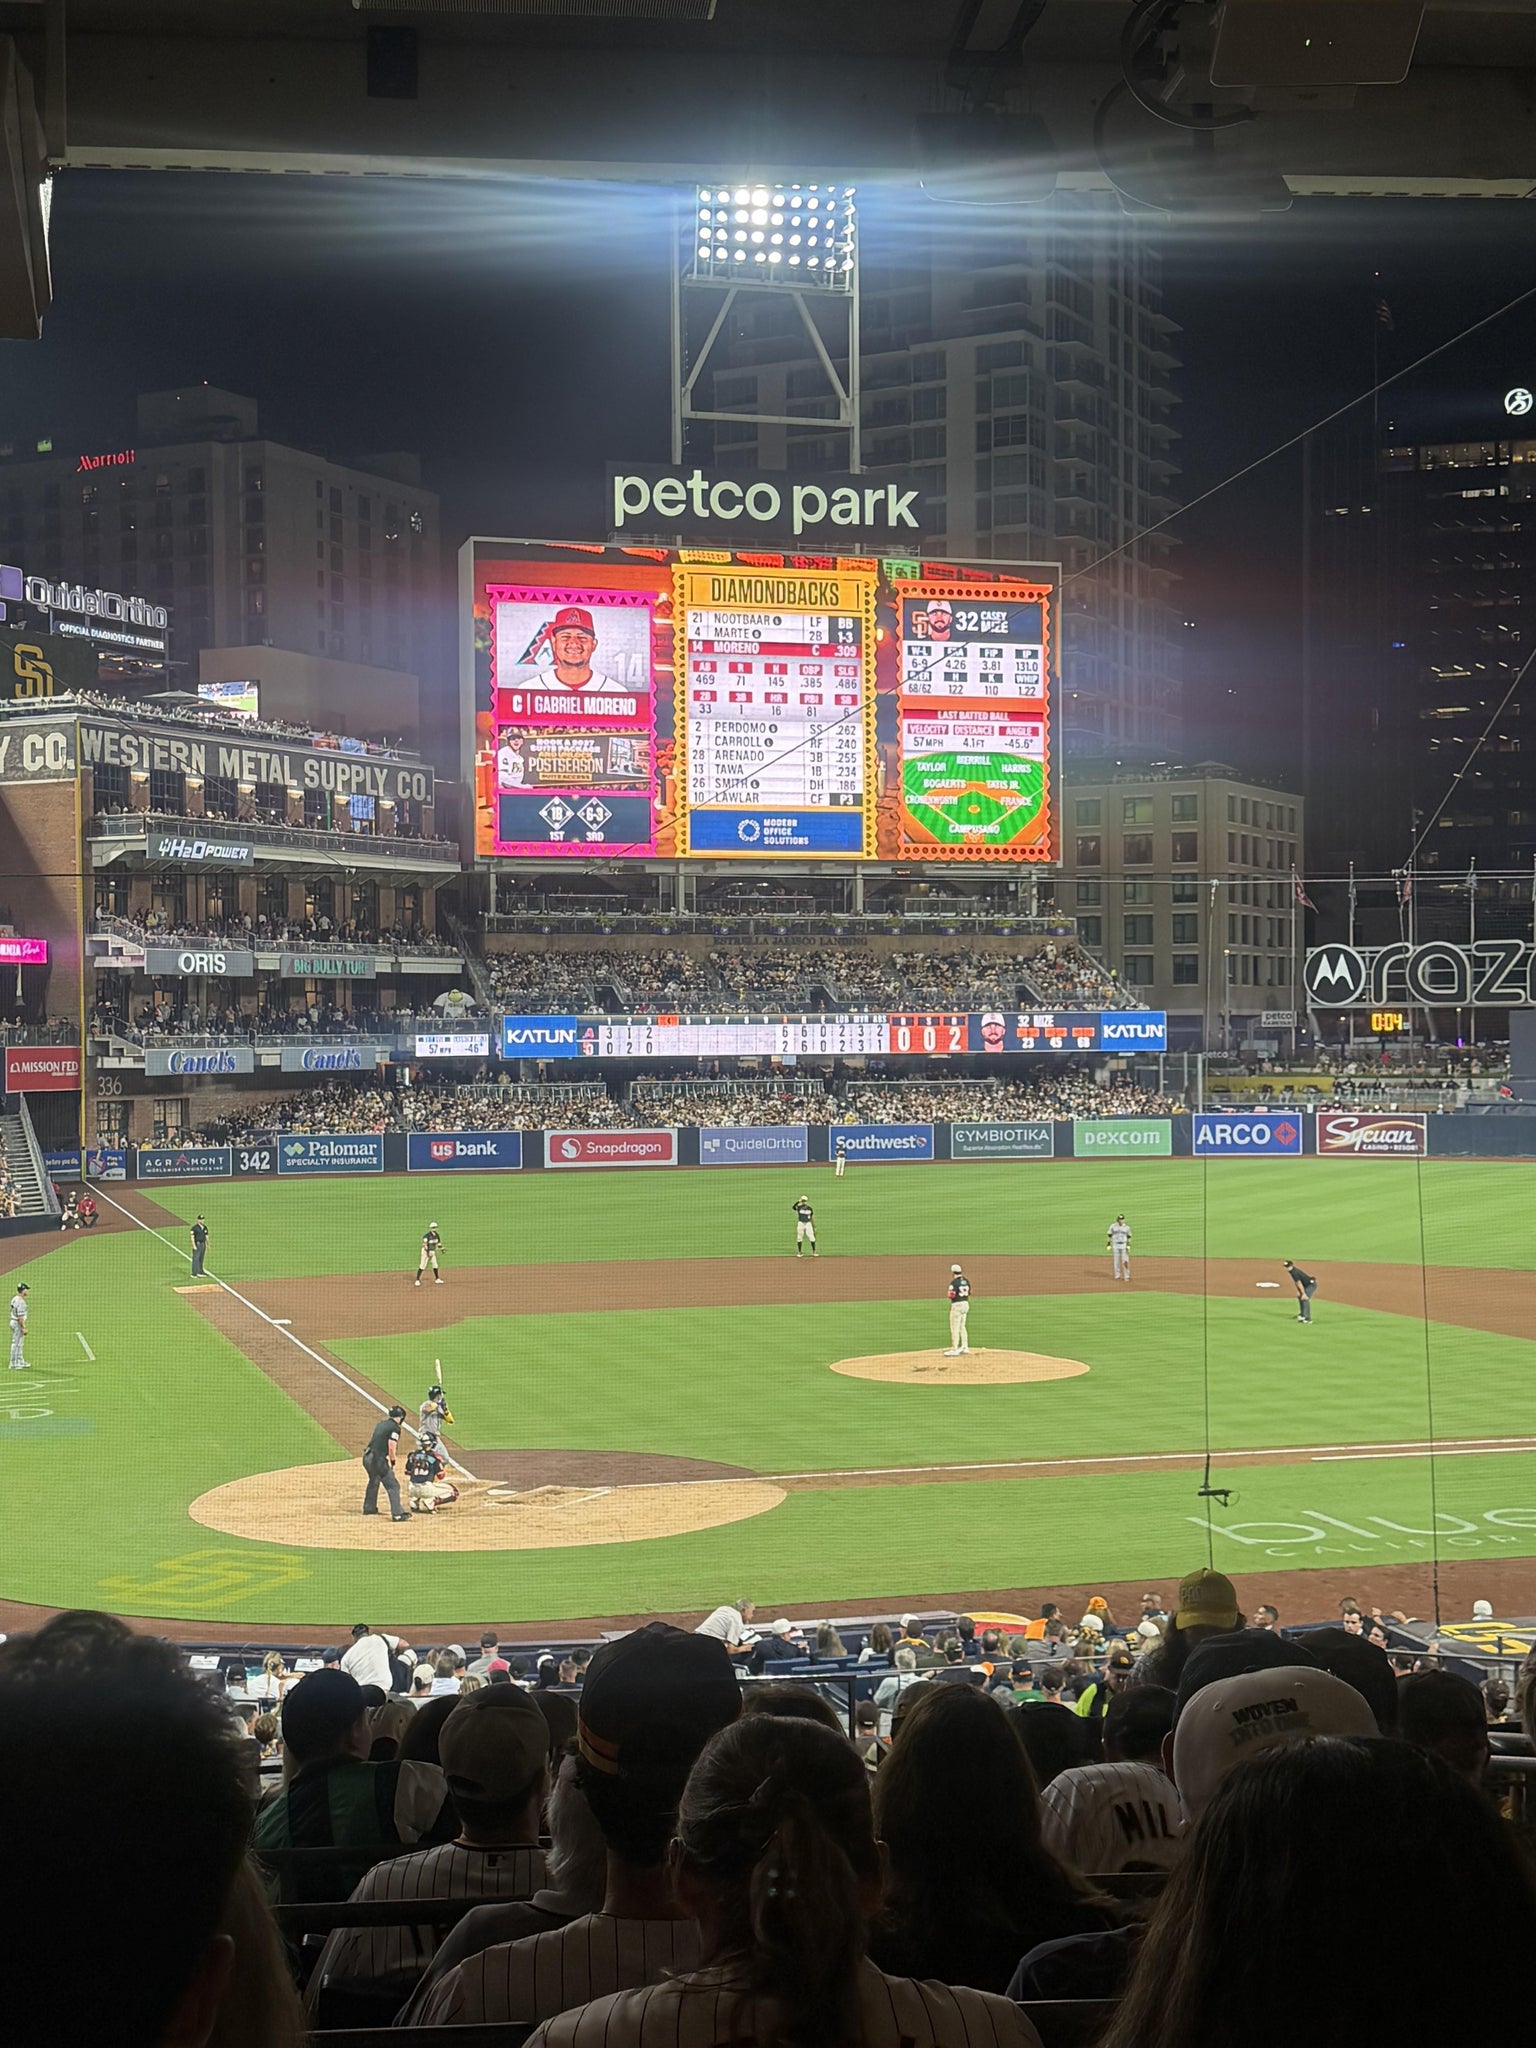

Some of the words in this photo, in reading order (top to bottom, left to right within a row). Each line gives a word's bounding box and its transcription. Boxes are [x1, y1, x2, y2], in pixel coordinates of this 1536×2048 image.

[614, 469, 781, 527] petco
[793, 484, 919, 535] park
[711, 578, 839, 606] DIAMONDBACKS
[25, 576, 167, 629] QuidelOrtho
[692, 612, 703, 623] 21
[714, 613, 770, 626] NOOTBAAR
[810, 617, 822, 628] LF
[955, 611, 979, 632] 32
[980, 611, 1007, 621] CASEY
[694, 626, 701, 636] 4
[714, 627, 749, 639] MARTE
[809, 631, 823, 641] 2B
[980, 621, 1009, 634] MIZE
[59, 623, 90, 637] OFFICIAL
[91, 628, 135, 645] DIAGNOSTICS
[136, 637, 165, 650] PARTNER
[692, 641, 703, 652] 14
[713, 642, 760, 655] MORENO
[812, 646, 820, 656] C
[834, 646, 857, 657] .309
[613, 652, 646, 688] 14
[911, 659, 928, 669] 6-9
[945, 660, 967, 670] 4.26
[982, 661, 1001, 671] 3.81
[1016, 662, 1038, 672] 131.0
[695, 674, 715, 685] 469
[736, 675, 746, 686] 71
[768, 676, 785, 687] 145
[800, 677, 822, 688] .385
[835, 678, 857, 689] .486
[1016, 675, 1038, 684] WHIP
[948, 685, 964, 695] 122
[985, 686, 998, 696] 110
[1018, 687, 1036, 697] 1.22
[512, 695, 523, 713] C
[534, 695, 583, 715] GABRIEL
[583, 697, 637, 716] MORENO
[699, 703, 712, 714] 33
[771, 705, 782, 716] 16
[806, 706, 817, 717] 81
[843, 707, 850, 717] 6
[937, 711, 958, 720] LAST
[958, 711, 989, 721] BATTED
[989, 712, 1010, 721] BALL
[695, 721, 702, 732] 2
[714, 722, 766, 733] PERDOMO
[809, 724, 823, 735] SS
[835, 725, 856, 736] .262
[909, 725, 947, 735] VELOCITY
[954, 726, 993, 736] DISTANCE
[1005, 727, 1033, 736] ANGLE
[695, 736, 702, 746] 7
[714, 736, 762, 748] CARROLL
[810, 738, 823, 749] RF
[835, 739, 857, 750] .240
[22, 732, 76, 772] CO.
[692, 750, 705, 760] 28
[715, 750, 765, 761] ARENADO
[810, 752, 823, 763] 3B
[835, 753, 857, 763] .255
[80, 728, 205, 775] WESTERN
[219, 746, 298, 786] METAL
[304, 758, 388, 797] SUPPLY
[397, 770, 432, 802] CO.
[528, 756, 604, 774] POSTSEASON
[694, 764, 704, 774] 13
[715, 764, 744, 775] TAWA
[811, 766, 822, 777] 1B
[835, 767, 857, 778] .234
[916, 762, 947, 772] TAYLOR
[1001, 764, 1032, 773] HARRIS
[692, 778, 706, 788] 26
[714, 778, 748, 789] SMITH
[809, 780, 824, 790] DH
[836, 780, 856, 791] .186
[923, 779, 967, 789] BOGAERTS
[986, 780, 1008, 789] TATIS
[693, 792, 705, 803] 10
[715, 792, 759, 803] LAWLAR
[810, 794, 823, 804] CF
[763, 818, 798, 827] MODERN
[949, 824, 1000, 834] CAMPUSANO
[549, 831, 565, 841] 1ST
[585, 831, 605, 842] 3RD
[763, 827, 792, 836] OFFICE
[763, 836, 809, 845] SOLUTIONS
[205, 844, 249, 860] POWER
[178, 953, 226, 974] ORIS
[293, 958, 311, 974] BIG
[312, 959, 343, 975] BULLY
[1371, 938, 1536, 1005] raz
[1017, 1015, 1030, 1027] 32
[1265, 1012, 1293, 1020] petco
[1371, 1012, 1403, 1032] 0:04
[507, 1030, 576, 1044] KATUN
[782, 1025, 789, 1038] 6
[801, 1025, 808, 1038] 6
[820, 1025, 827, 1038] 0
[1103, 1025, 1164, 1039] KATUN
[897, 1027, 911, 1051] 0
[923, 1027, 937, 1051] 0
[949, 1027, 962, 1050] 2
[428, 1043, 438, 1054] 57
[606, 1041, 613, 1055] 0
[626, 1041, 633, 1054] 2
[646, 1041, 653, 1055] 0
[801, 1040, 808, 1052] 6
[820, 1040, 827, 1053] 0
[858, 1040, 864, 1052] 3
[22, 1061, 60, 1073] MISSION
[61, 1060, 79, 1072] FED
[168, 1050, 237, 1074] Canel's
[97, 1076, 122, 1096] 336
[955, 1128, 1050, 1142] CYMBIOTIKA
[1196, 1123, 1271, 1145] ARCO
[1325, 1117, 1416, 1152] Sycuan
[308, 1141, 377, 1157] Palomar
[432, 1144, 453, 1156] us
[455, 1140, 497, 1156] bank
[586, 1141, 662, 1156] Snapdragon
[724, 1138, 802, 1152] QuidelOrtho
[835, 1134, 916, 1150] Southwest
[145, 1153, 224, 1167] AGRAMONT
[240, 1151, 271, 1171] 342
[286, 1157, 330, 1166] SPECIALTY
[332, 1156, 378, 1165] INSURANCE
